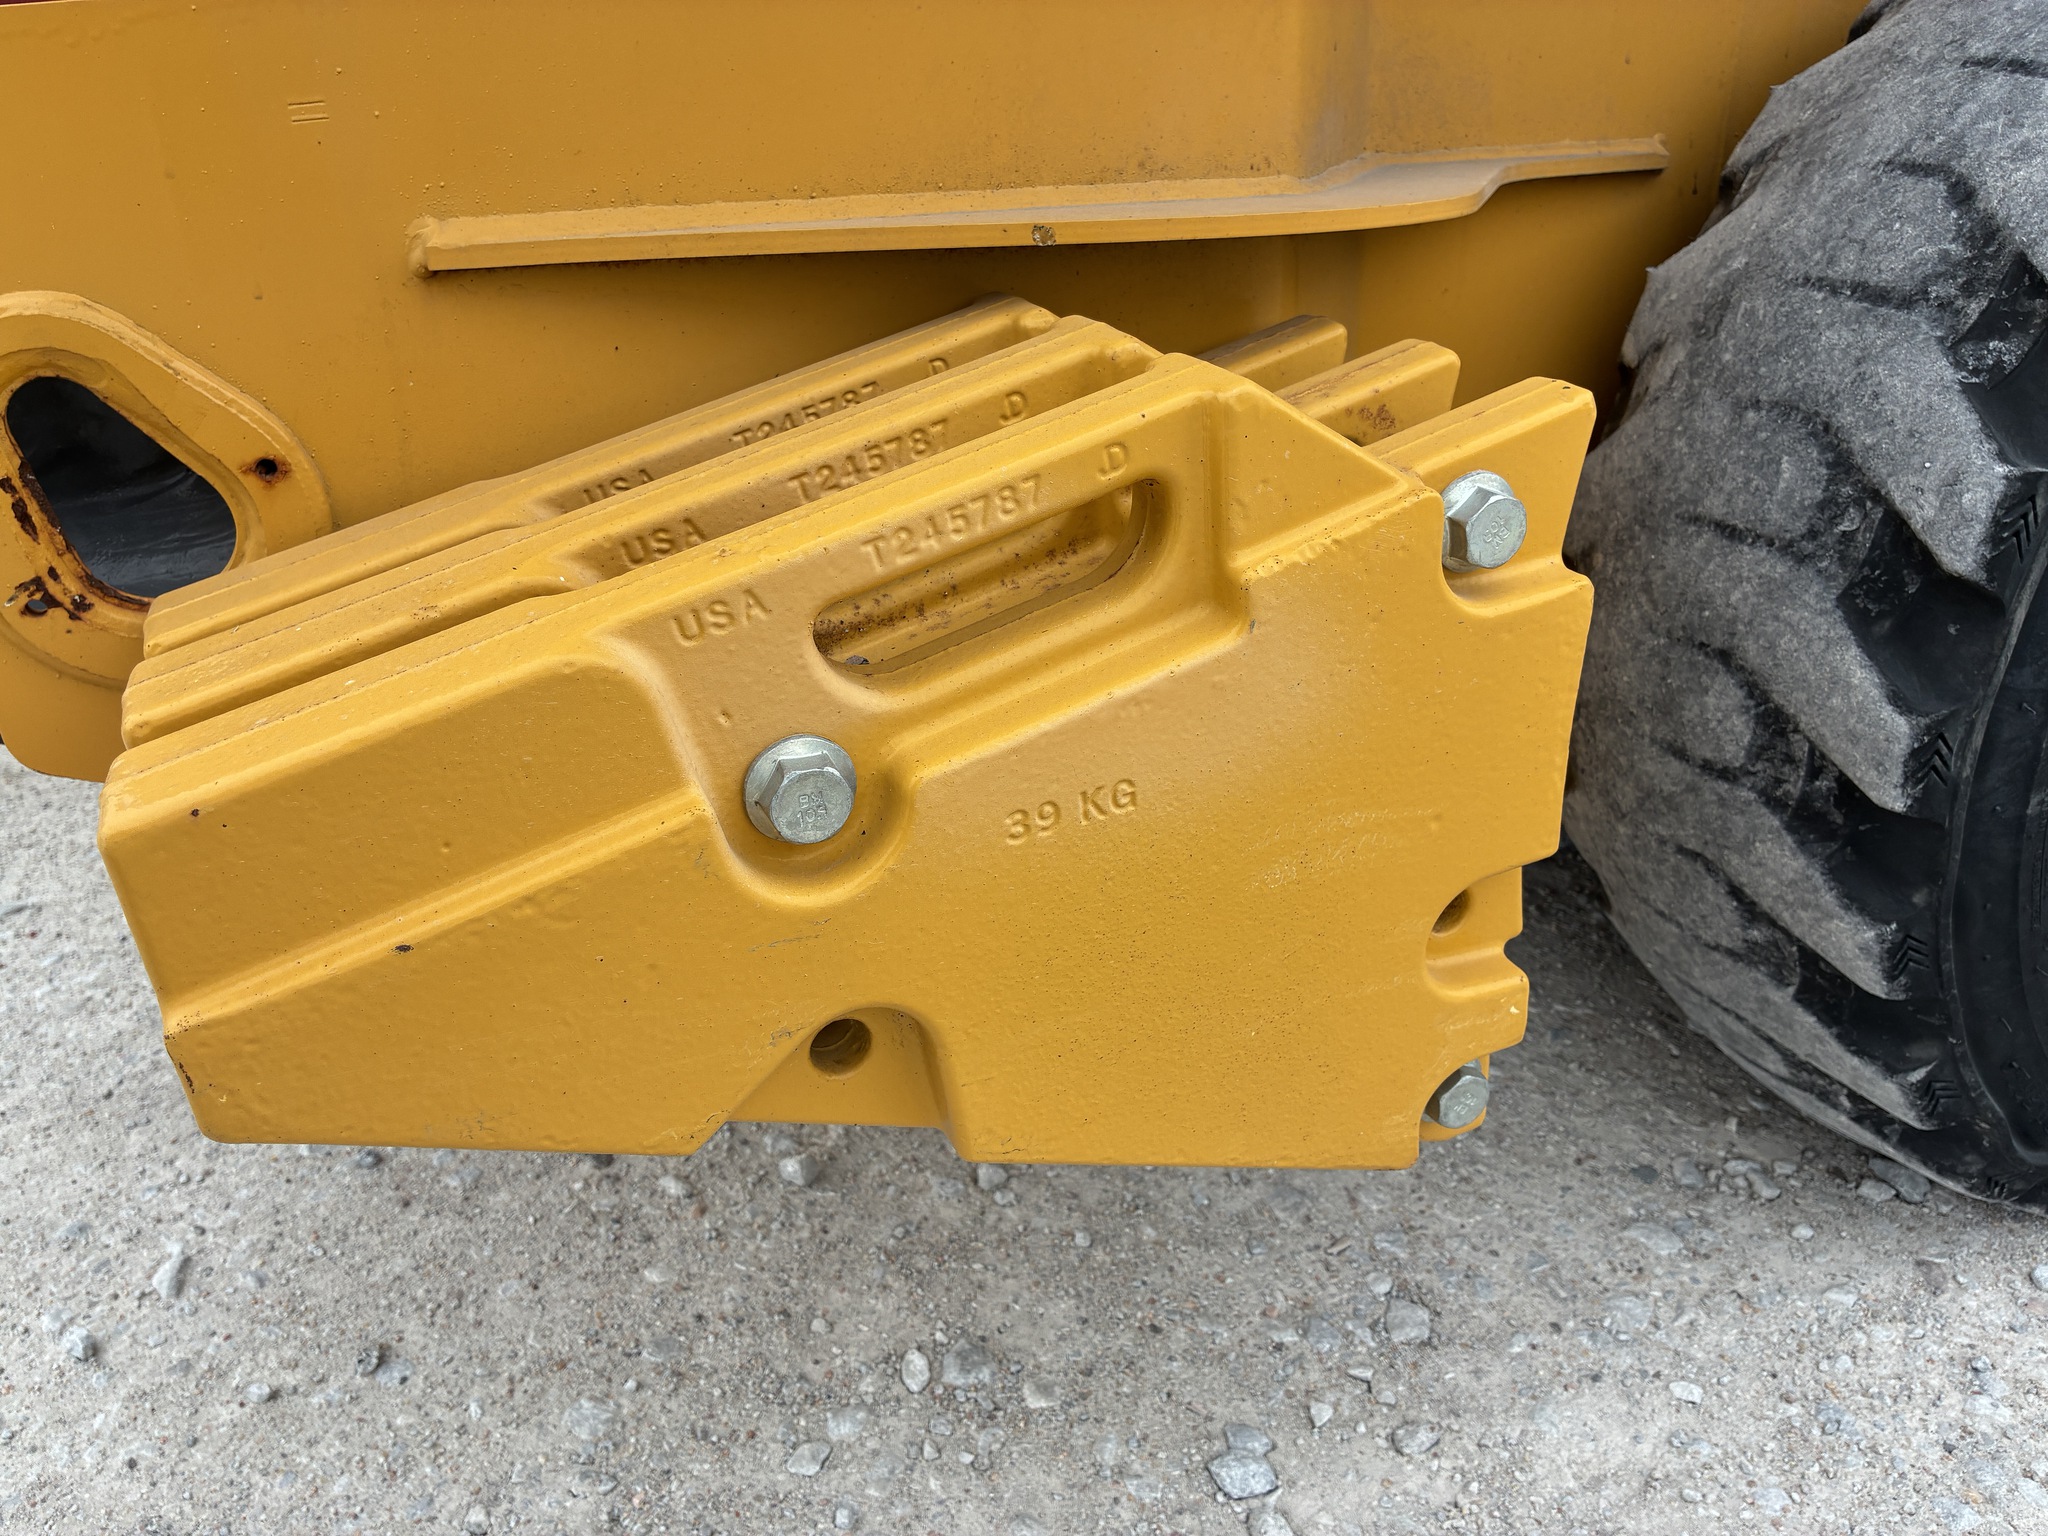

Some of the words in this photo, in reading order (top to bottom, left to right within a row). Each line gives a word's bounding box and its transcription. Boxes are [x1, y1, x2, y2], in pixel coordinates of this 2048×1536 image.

[619, 516, 707, 567] USA
[786, 418, 949, 504] T245787
[672, 586, 773, 647] USA
[860, 472, 1043, 573] T245787
[1003, 799, 1062, 845] 39
[1078, 778, 1138, 826] KG
